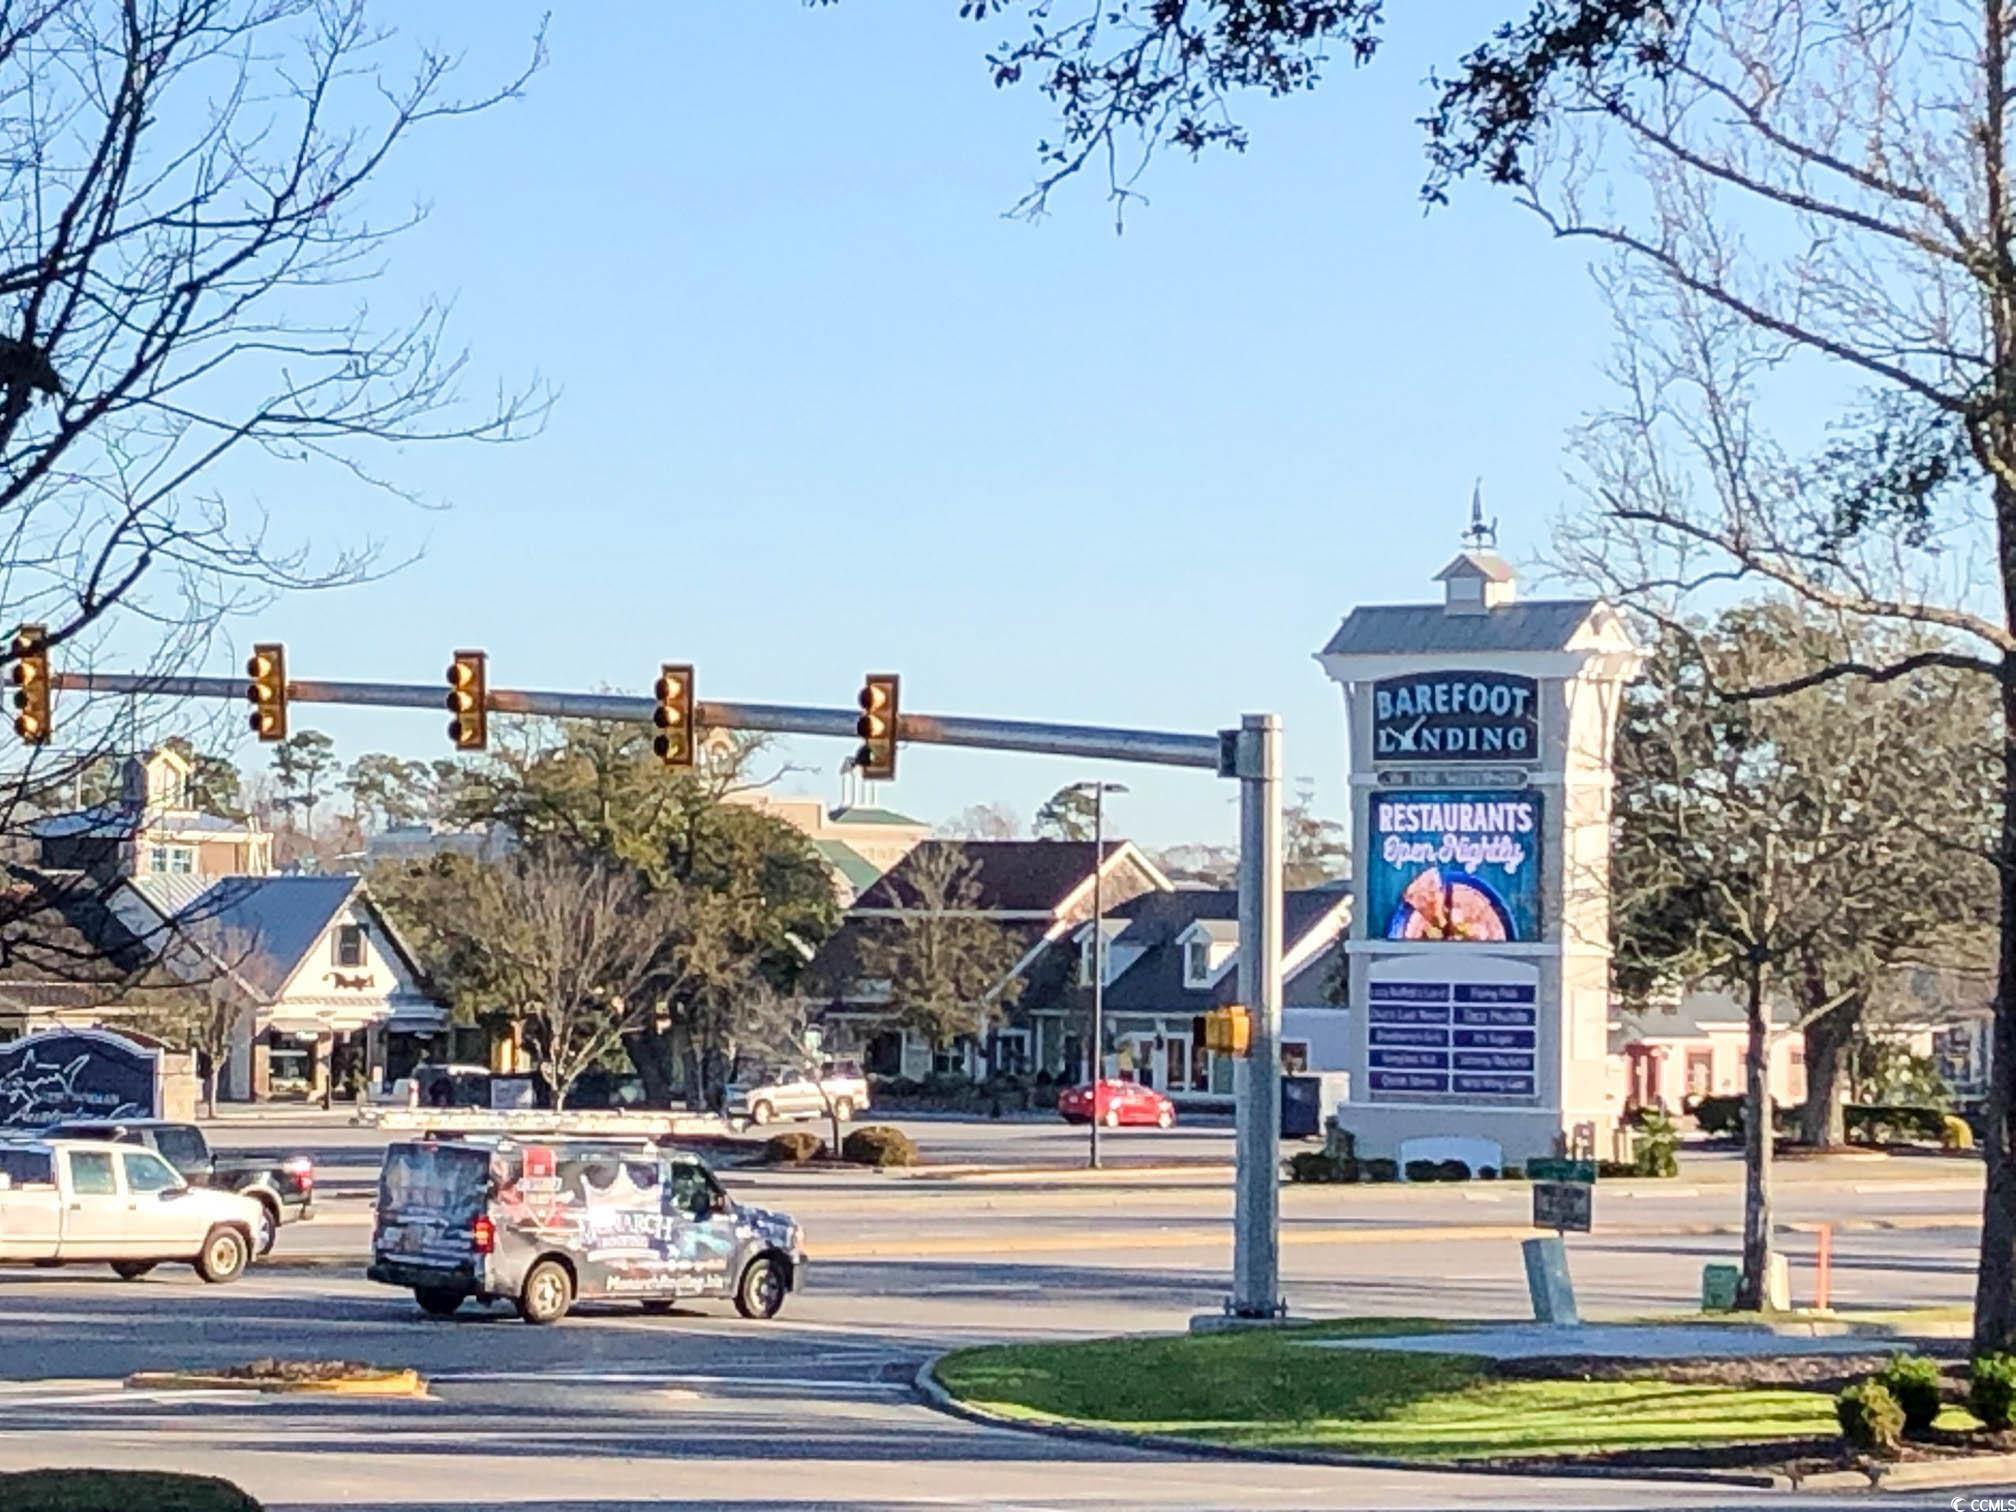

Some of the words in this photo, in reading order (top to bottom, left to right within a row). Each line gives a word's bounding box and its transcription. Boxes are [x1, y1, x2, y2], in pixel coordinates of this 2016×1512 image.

[1376, 682, 1530, 720] BAREFOOT
[1378, 802, 1534, 833] RESTAURANTS
[1383, 834, 1437, 870] Open
[1438, 832, 1526, 874] Nightly
